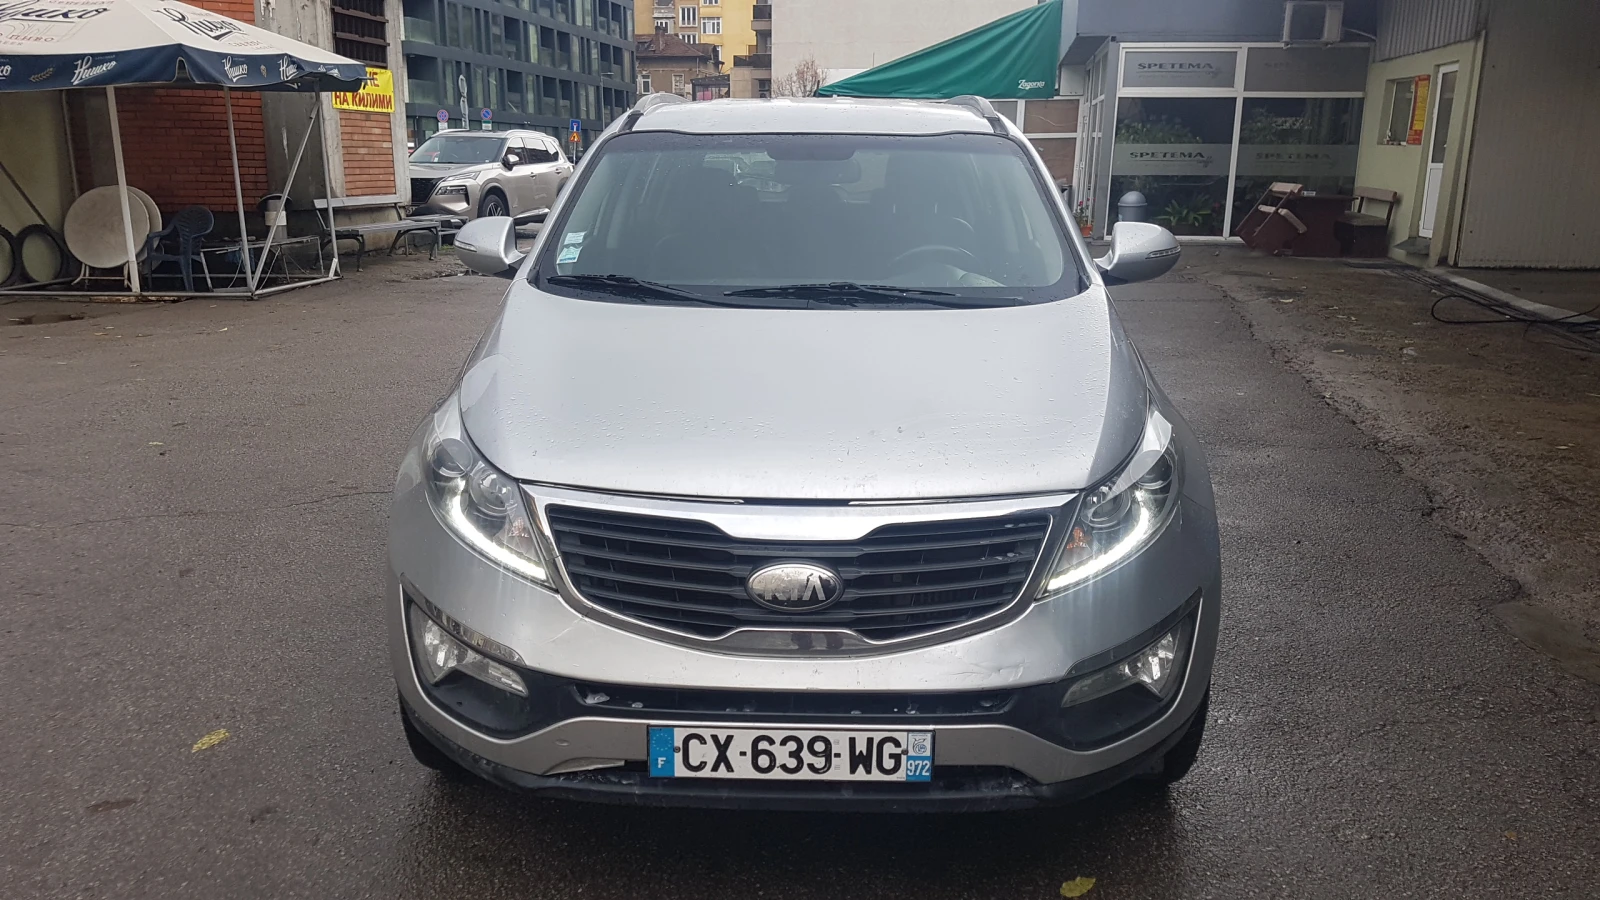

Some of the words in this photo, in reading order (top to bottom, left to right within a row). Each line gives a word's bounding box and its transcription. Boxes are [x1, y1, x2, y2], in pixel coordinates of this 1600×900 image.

[1137, 62, 1214, 70] SPETEMA
[334, 91, 350, 106] НА
[352, 91, 393, 110] КИЛИМИ
[1129, 151, 1206, 159] SPETEMA
[763, 573, 827, 601] KIA
[682, 732, 902, 776] CX-639-WG
[657, 757, 667, 769] F
[906, 760, 931, 776] 972
